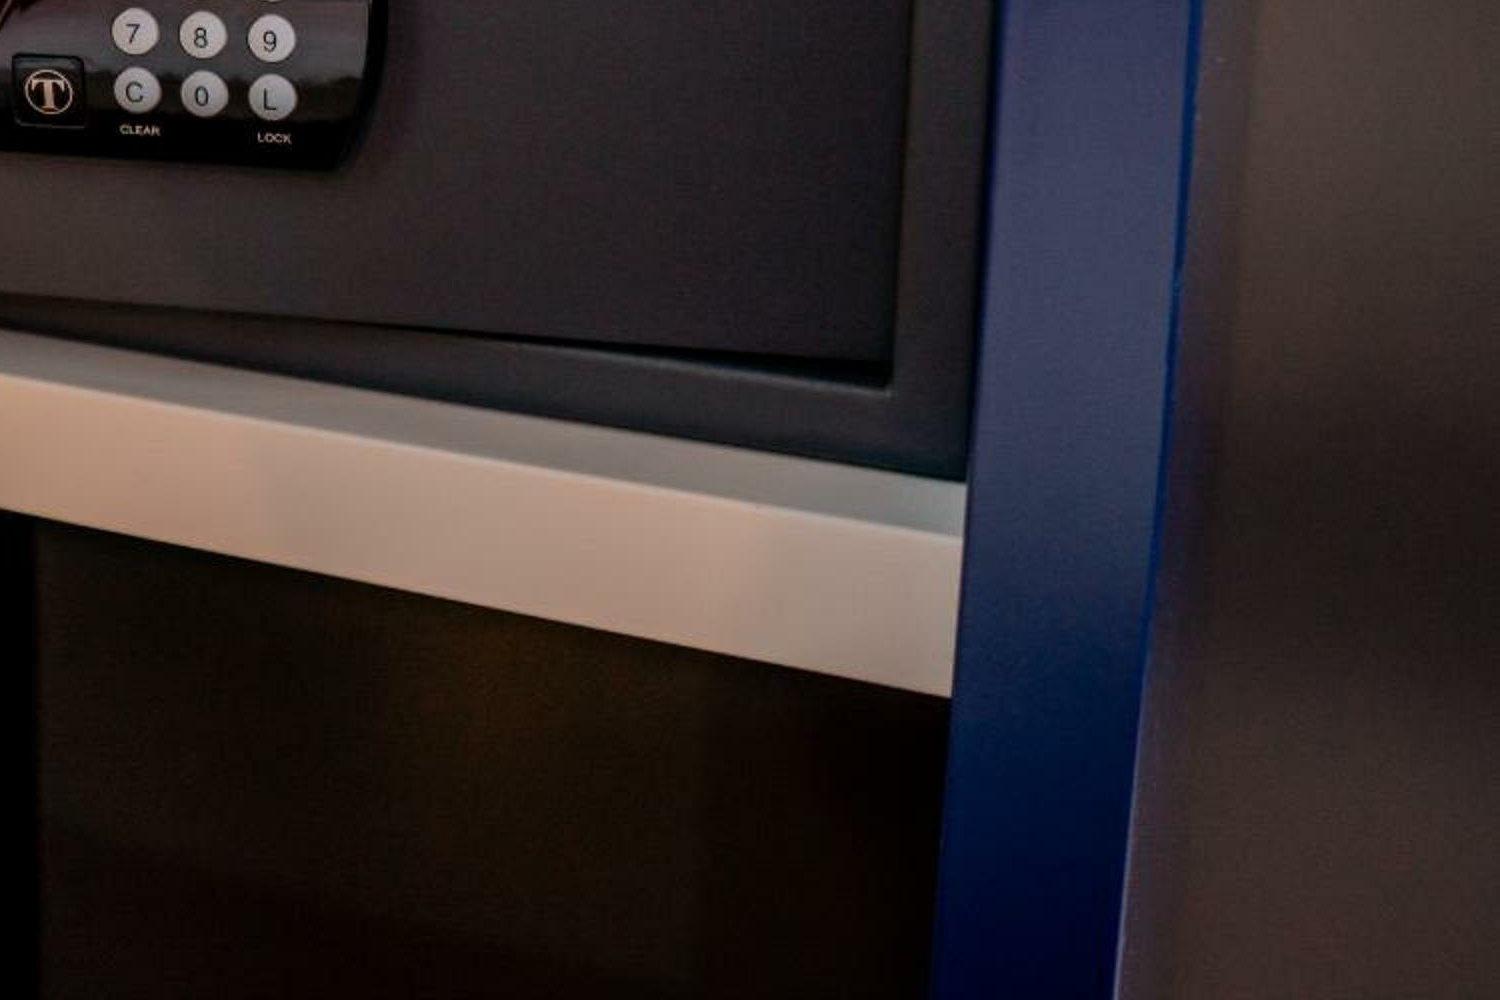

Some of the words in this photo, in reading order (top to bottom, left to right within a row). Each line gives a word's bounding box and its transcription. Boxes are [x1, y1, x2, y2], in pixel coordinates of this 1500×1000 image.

[125, 23, 140, 44] 7
[193, 27, 208, 49] 8
[263, 30, 277, 52] 9
[125, 81, 144, 103] C
[194, 85, 209, 107] 0
[263, 88, 277, 111] L
[119, 124, 161, 136] CLEAR
[257, 132, 291, 144] LOCK
